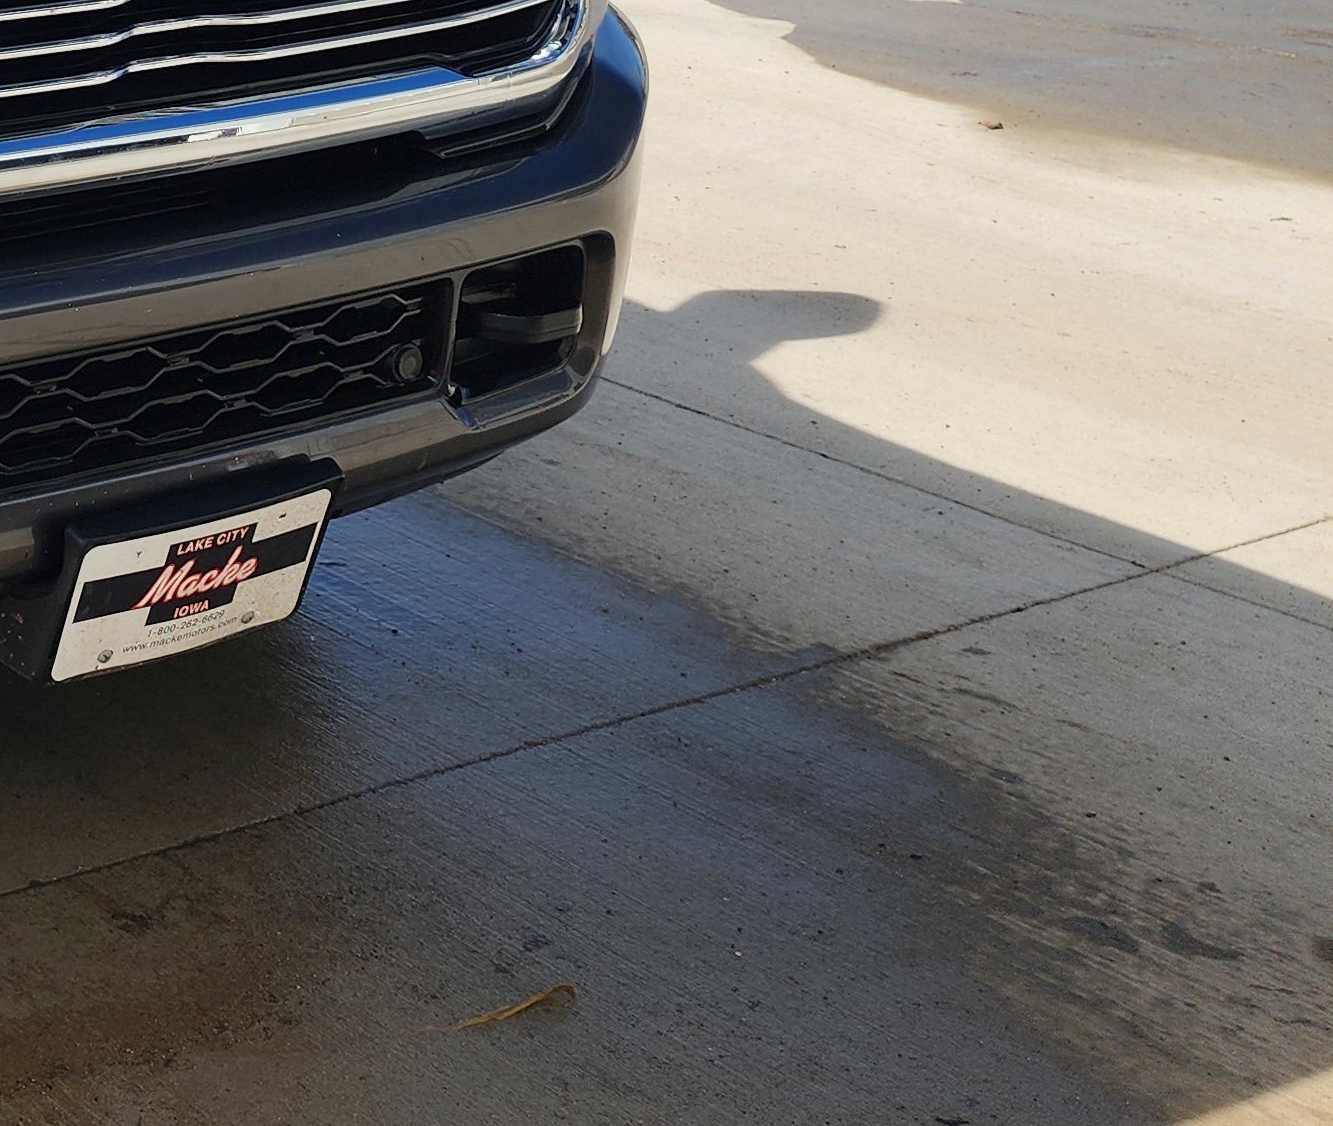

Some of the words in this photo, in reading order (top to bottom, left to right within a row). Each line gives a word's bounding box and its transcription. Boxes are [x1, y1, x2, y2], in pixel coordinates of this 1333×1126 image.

[176, 537, 214, 556] LAKE
[216, 526, 250, 546] CITY
[131, 545, 259, 610] Macke
[147, 609, 226, 638] 1-800-262-6629
[173, 599, 210, 619] IOWA
